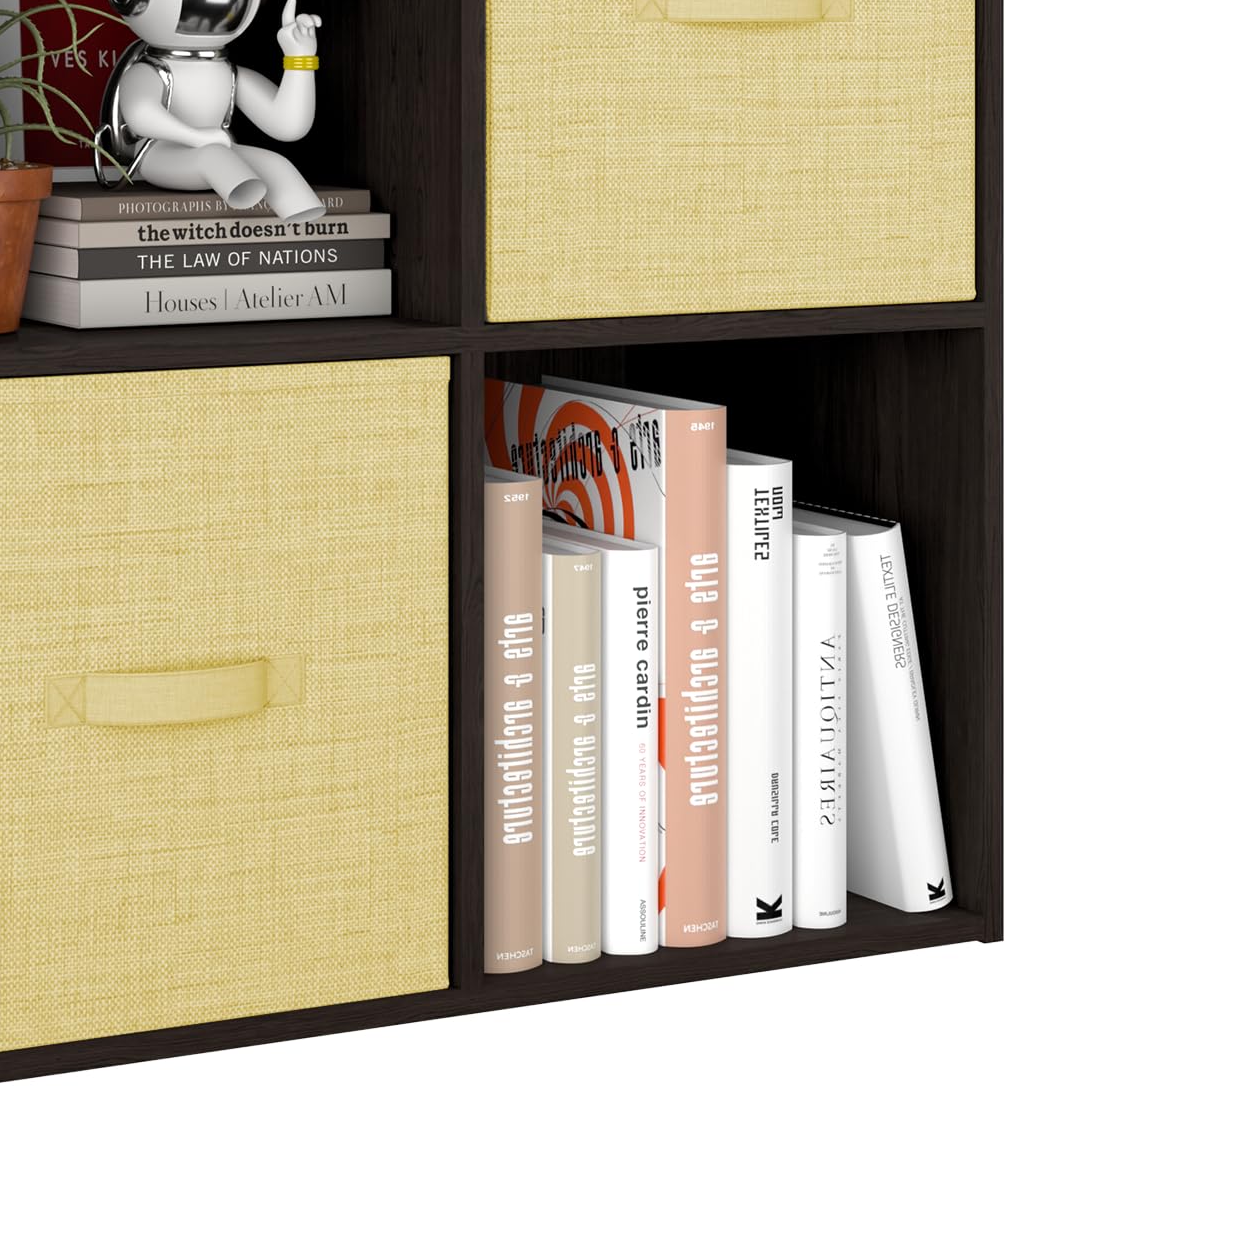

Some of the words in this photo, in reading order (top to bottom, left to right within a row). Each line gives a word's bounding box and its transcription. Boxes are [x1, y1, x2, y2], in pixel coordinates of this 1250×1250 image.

[51, 49, 87, 68] VES
[118, 200, 212, 215] PHOTOGRAPHS
[137, 224, 172, 243] the
[173, 222, 226, 240] witch
[304, 220, 349, 236] burn
[137, 253, 175, 270] THE
[183, 252, 221, 268] LAW
[227, 251, 251, 267] OF
[259, 248, 338, 265] NATIONS
[145, 290, 218, 314] Houses
[234, 284, 304, 310] Atelier
[307, 282, 349, 307] AM
[633, 586, 651, 651] pierre
[636, 658, 651, 729] cardin
[638, 758, 647, 787] YEARS
[638, 790, 647, 803] OF
[638, 806, 647, 863] INNOVATION
[638, 899, 647, 943] ASSOULINE
